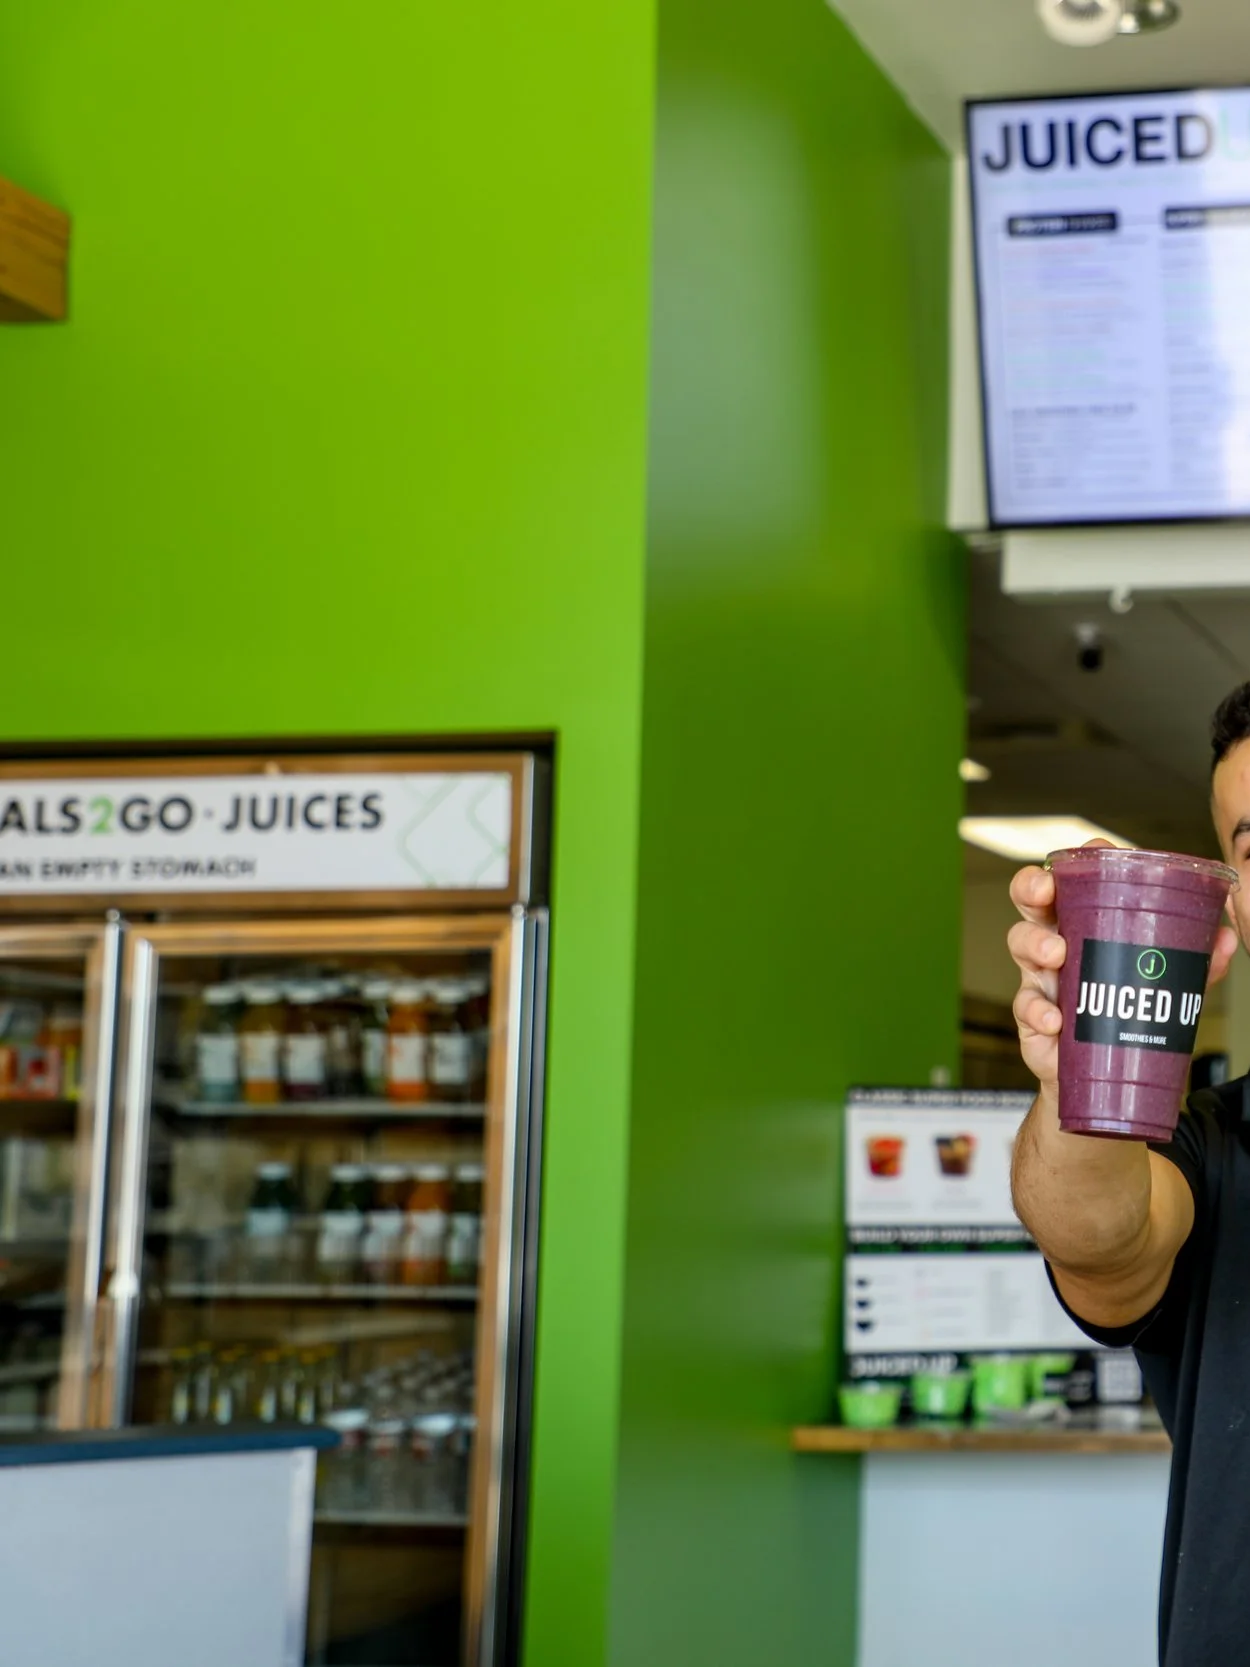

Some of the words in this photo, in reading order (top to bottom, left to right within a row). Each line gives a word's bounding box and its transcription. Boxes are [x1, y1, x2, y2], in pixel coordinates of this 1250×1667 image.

[983, 113, 1213, 173] JUICED
[223, 792, 384, 832] JUICES
[41, 859, 121, 879] EMPTY
[132, 857, 257, 878] STOMACH
[1076, 981, 1172, 1023] JUICED
[1179, 992, 1202, 1026] UP
[1119, 1032, 1149, 1044] SMOOTHIES
[1153, 1036, 1167, 1045] MORE
